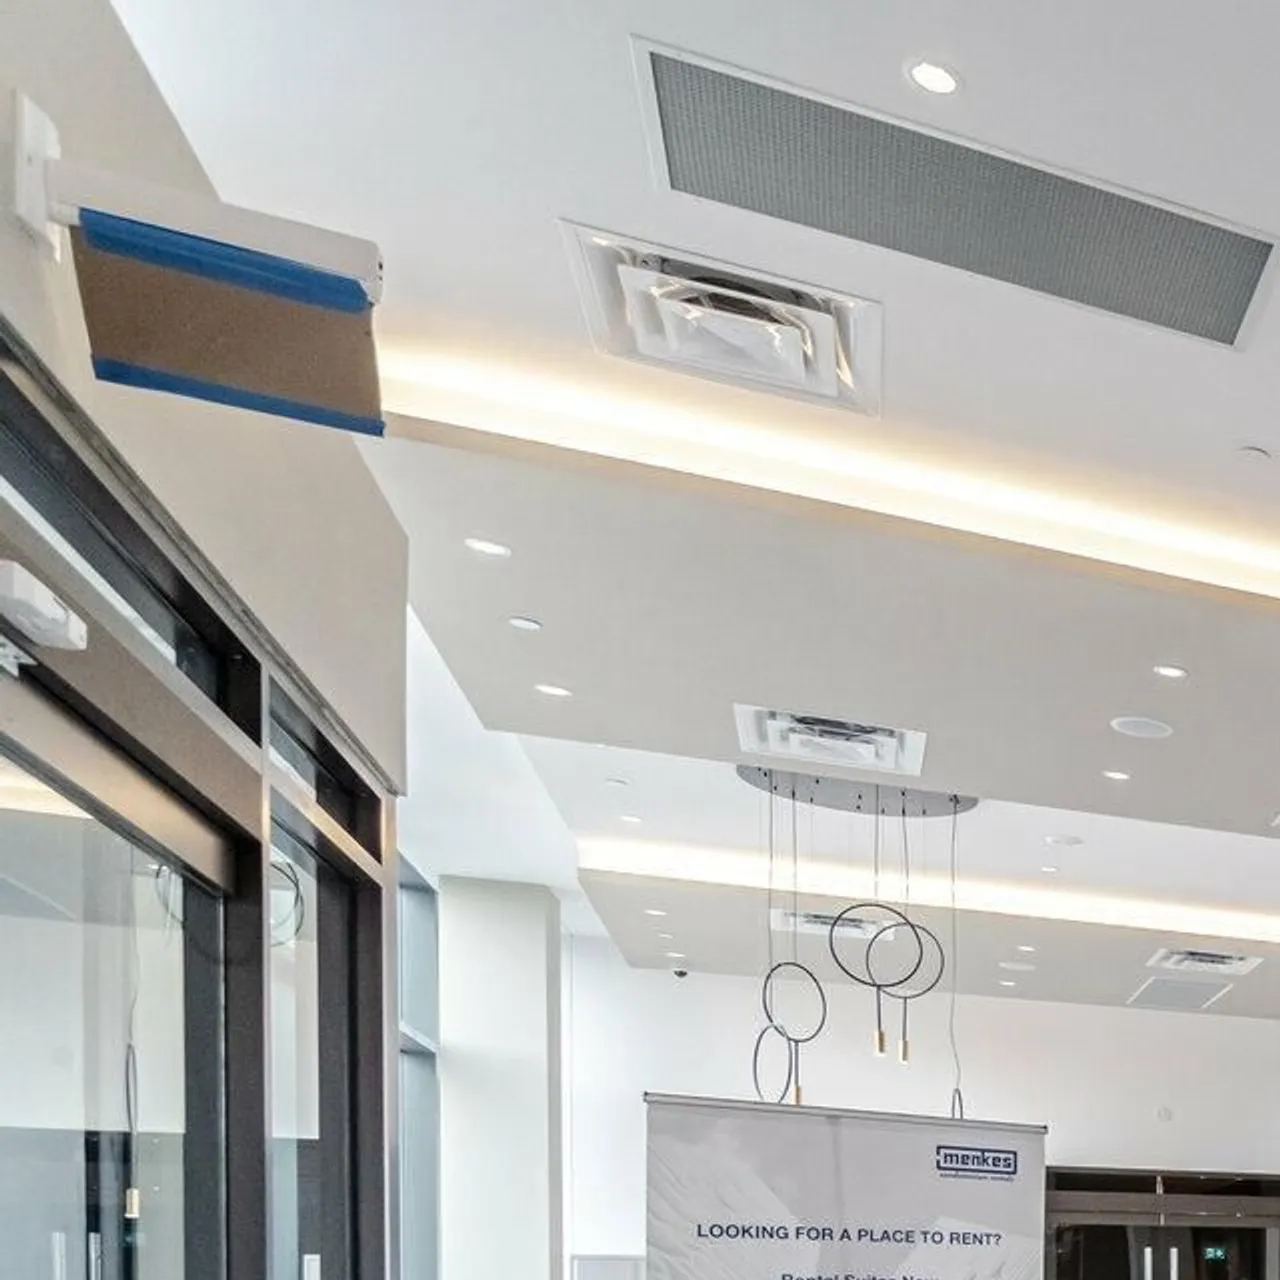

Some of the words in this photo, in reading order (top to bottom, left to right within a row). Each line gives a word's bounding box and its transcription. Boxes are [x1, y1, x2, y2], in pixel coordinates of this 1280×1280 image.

[943, 1151, 1012, 1168] menkes
[697, 1224, 789, 1240] LOOKING
[795, 1226, 834, 1241] FOR
[839, 1228, 851, 1241] A
[857, 1229, 915, 1244] PLACE
[921, 1230, 944, 1245] TO
[949, 1232, 1002, 1246] RENT?
